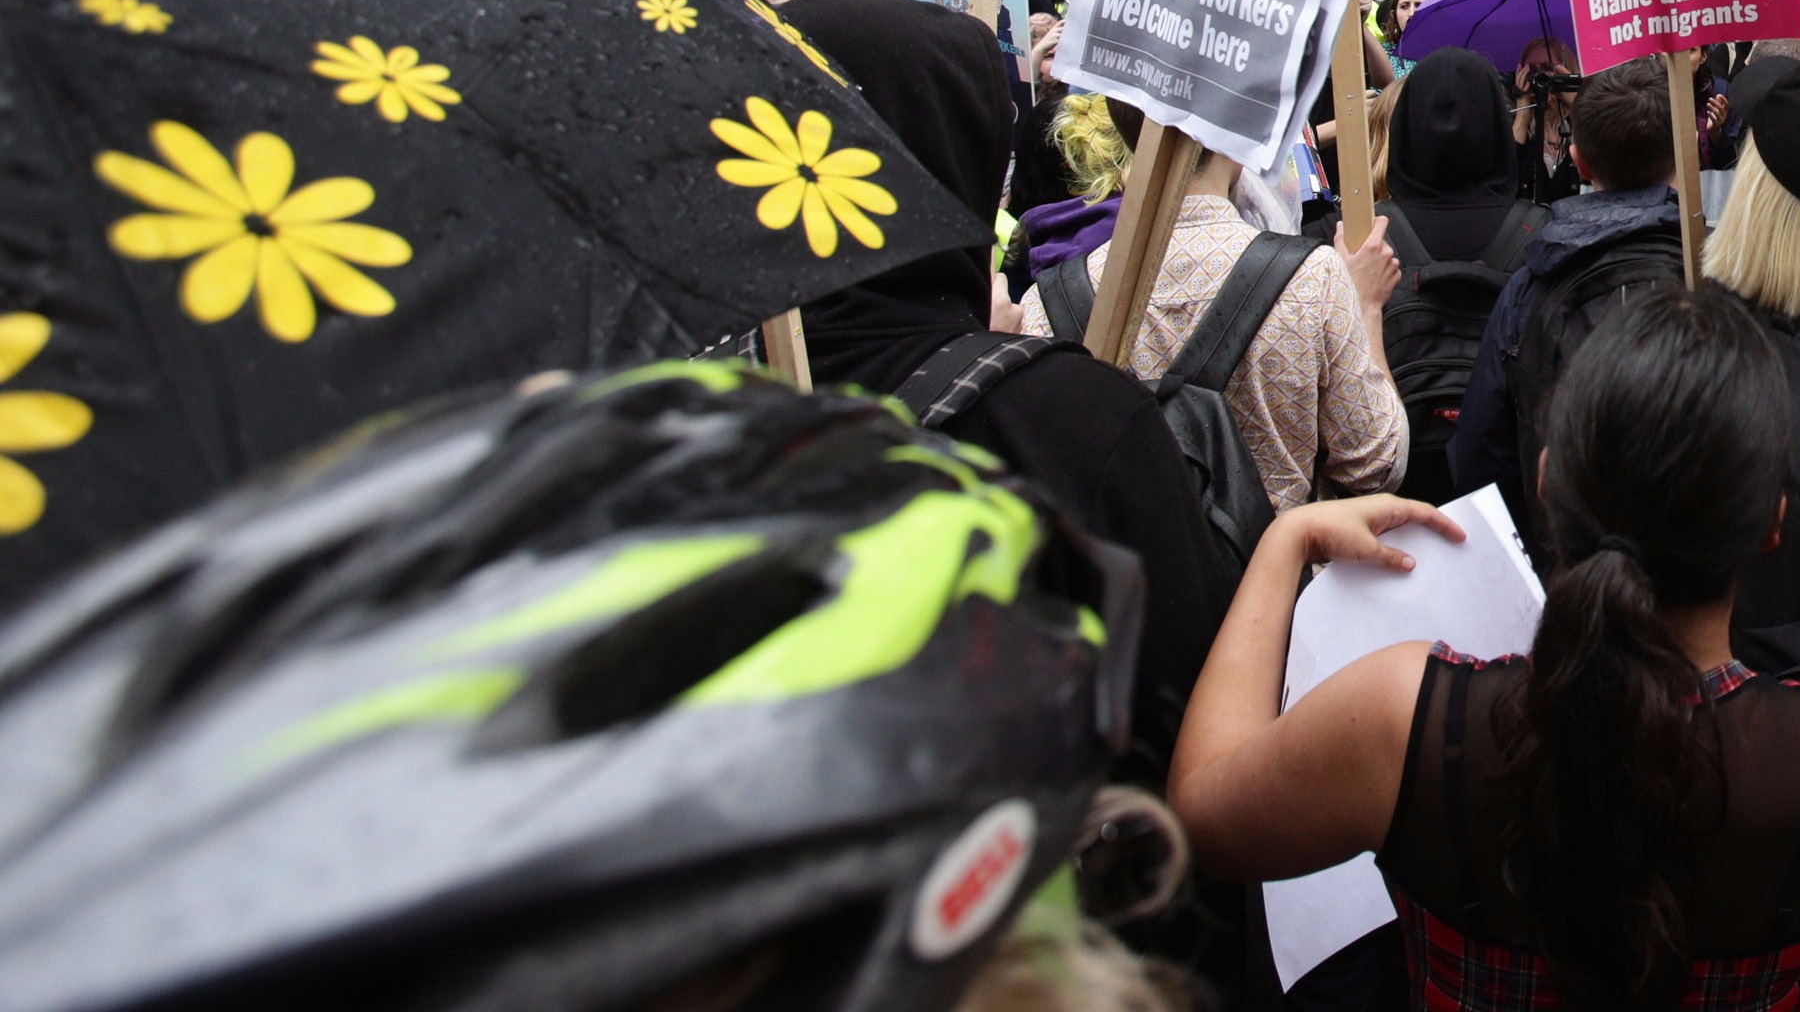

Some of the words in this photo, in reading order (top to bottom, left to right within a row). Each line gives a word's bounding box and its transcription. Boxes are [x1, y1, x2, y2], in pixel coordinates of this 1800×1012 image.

[1200, 13, 1250, 72] here
[1610, 19, 1642, 46] not
[1647, 0, 1758, 37] migrants
[1092, 44, 1193, 101] www.swp.org.uk
